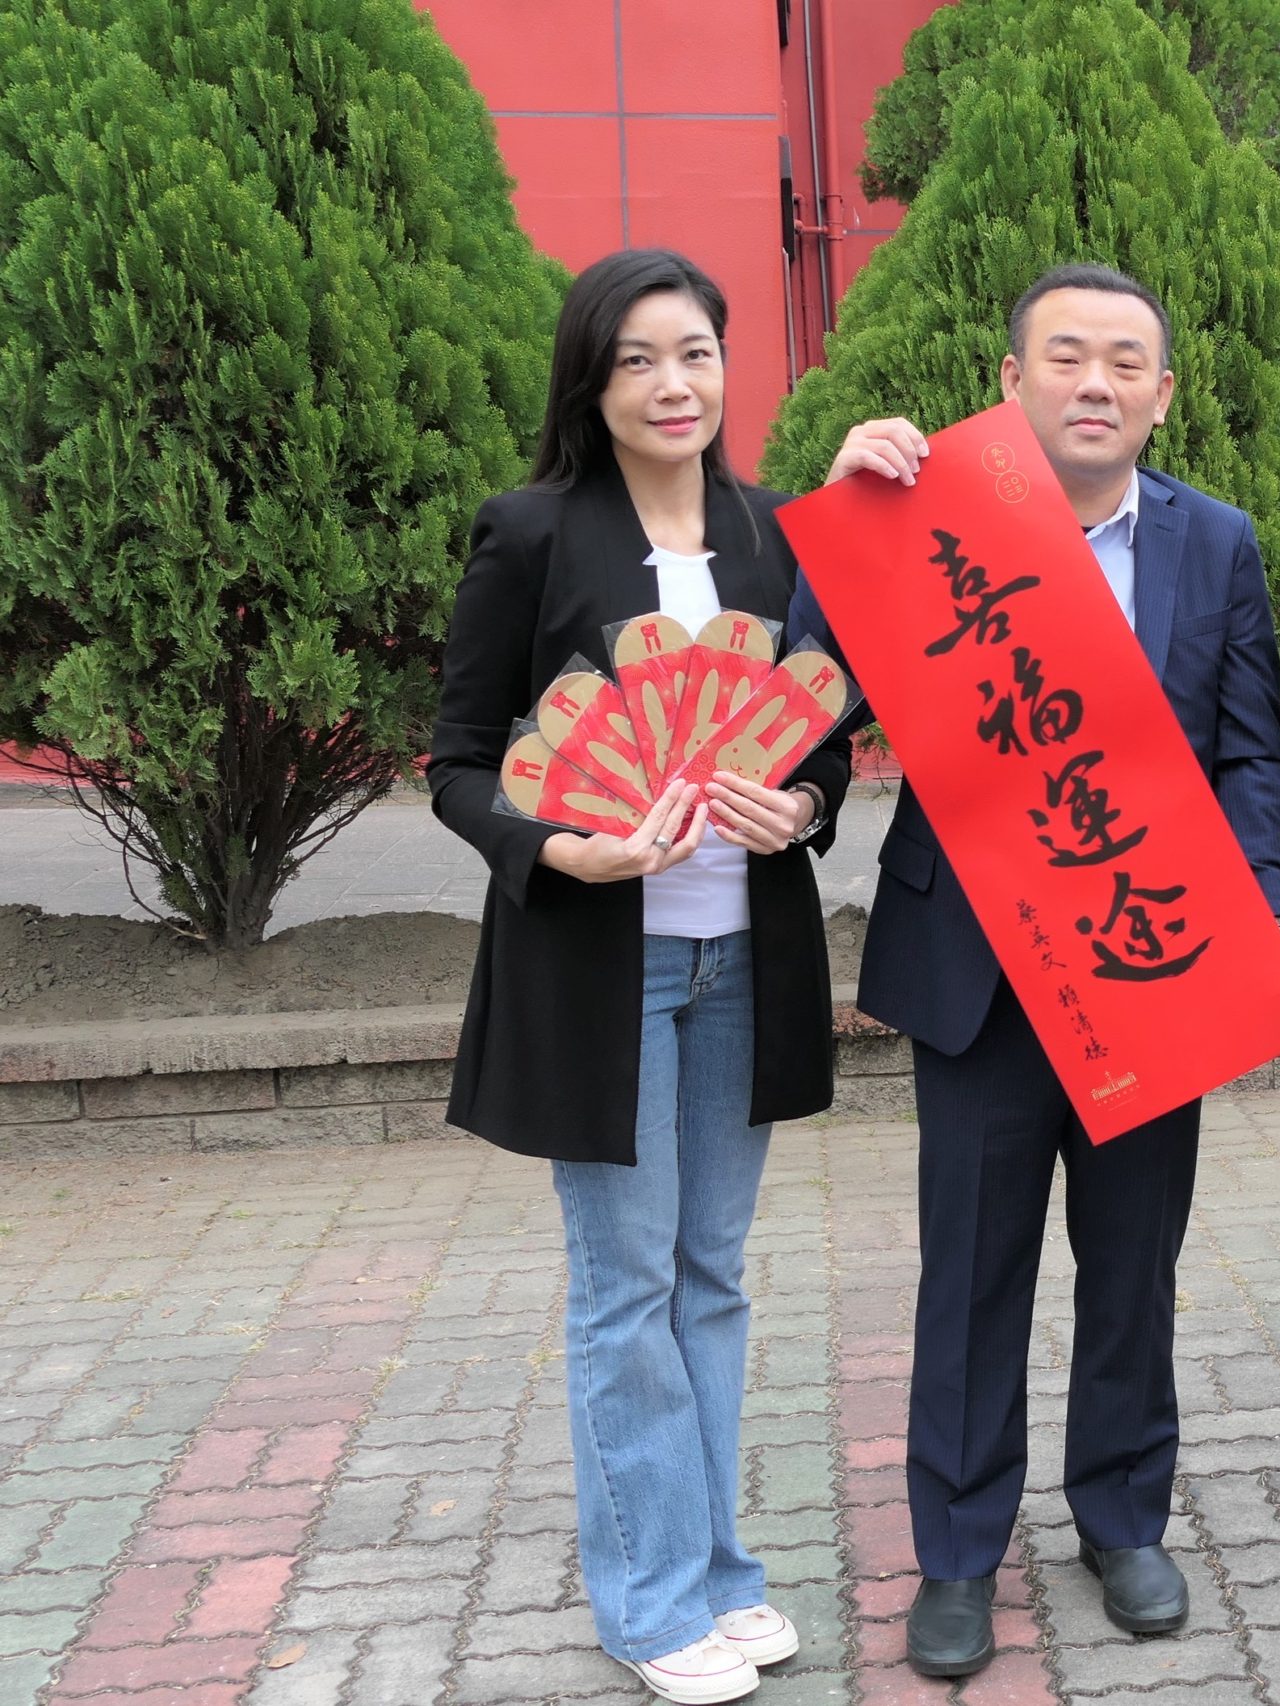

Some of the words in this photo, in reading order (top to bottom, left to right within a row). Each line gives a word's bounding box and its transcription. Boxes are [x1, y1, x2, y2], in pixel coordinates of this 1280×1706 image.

[924, 529, 1213, 981] 喜福運途
[1016, 899, 1067, 971] 蔡英文
